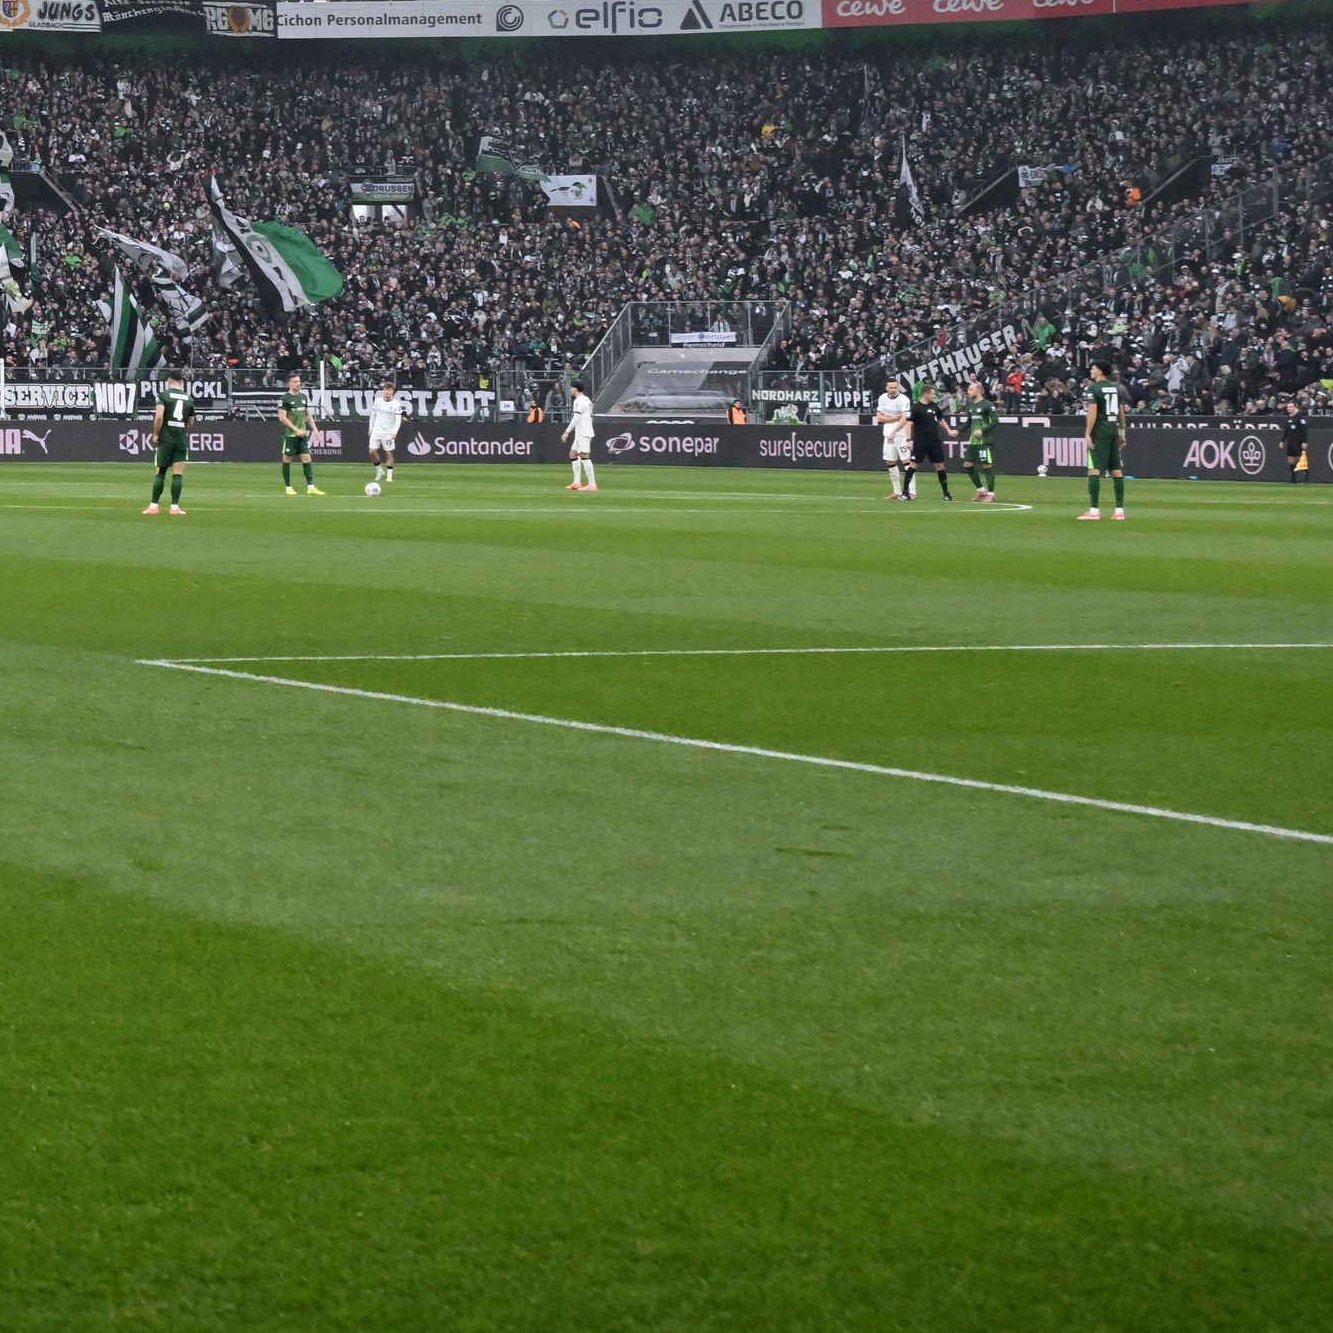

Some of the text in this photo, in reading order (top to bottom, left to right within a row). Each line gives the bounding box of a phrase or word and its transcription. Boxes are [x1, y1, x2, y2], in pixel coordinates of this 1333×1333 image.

[38, 0, 95, 21] JUNGS
[720, 0, 804, 22] ABECO
[276, 12, 483, 31] Cichon Personalmanagement
[752, 389, 819, 401] NORDHARZ
[825, 392, 871, 407] FUPPE
[173, 400, 183, 421] 4
[1107, 395, 1122, 419] 14
[435, 436, 533, 455] Santander
[639, 434, 719, 457] sonepar
[760, 431, 852, 462] sure[secure]
[1184, 440, 1236, 469] AOK
